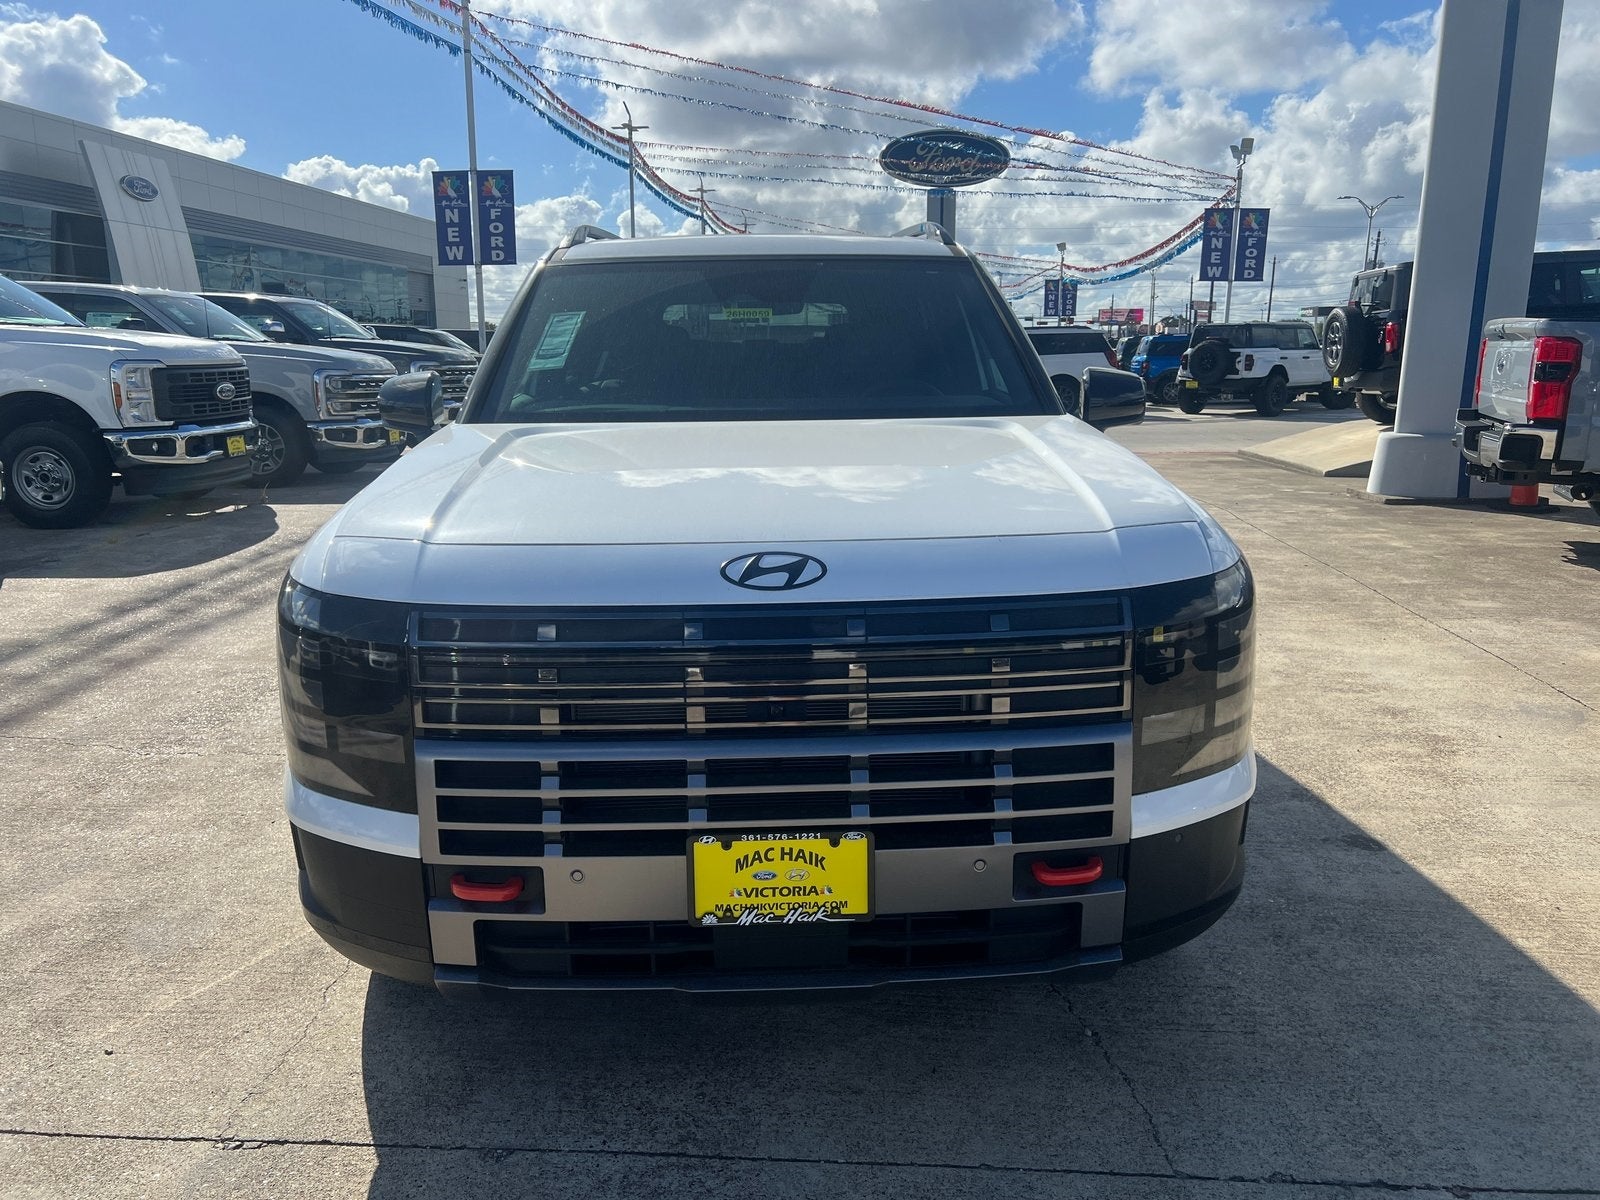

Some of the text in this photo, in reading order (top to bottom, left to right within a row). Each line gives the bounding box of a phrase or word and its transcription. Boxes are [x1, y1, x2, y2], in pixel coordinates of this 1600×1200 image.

[909, 141, 981, 173] Ford
[445, 208, 464, 260] NEW
[489, 208, 505, 261] FORD
[1207, 237, 1223, 278] NEW
[1243, 237, 1258, 279] FORD
[1047, 294, 1056, 316] NEW
[1065, 294, 1073, 316] FORD
[741, 832, 821, 841] 361-576-1221
[735, 846, 826, 874] MAC HAIK
[755, 870, 775, 880] Ford
[743, 886, 819, 898] VICTORIA
[714, 900, 848, 912] MACHAIKVICTORIACOM
[736, 906, 847, 926] Mac Haik
